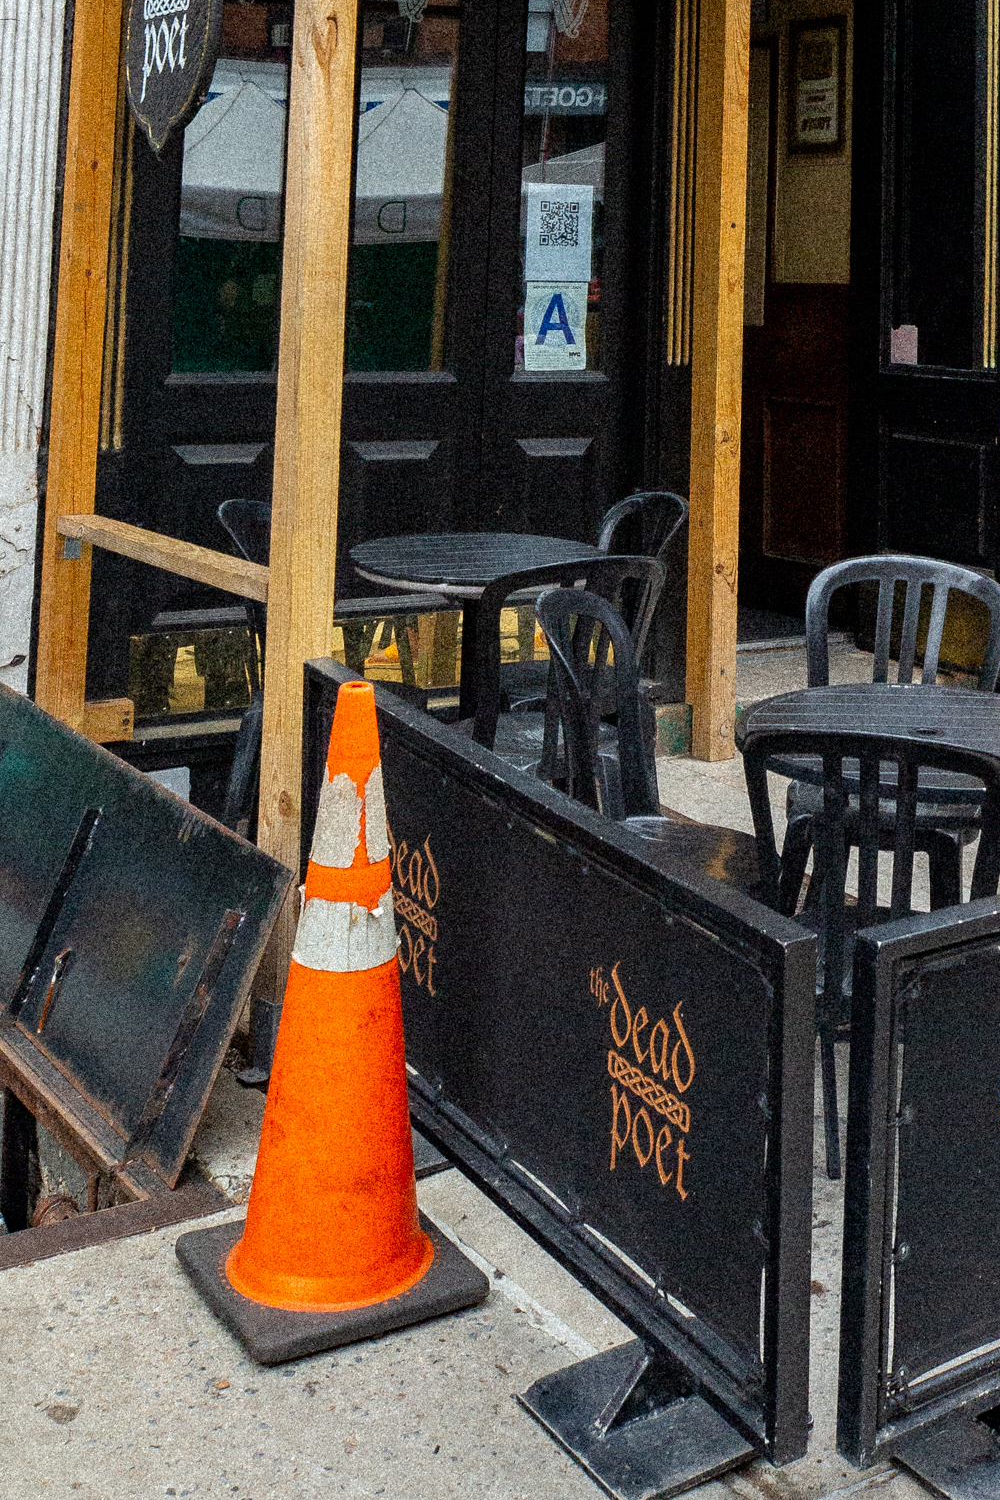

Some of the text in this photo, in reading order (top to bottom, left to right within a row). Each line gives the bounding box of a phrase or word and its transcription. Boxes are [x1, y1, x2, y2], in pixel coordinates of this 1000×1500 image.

[140, 13, 189, 103] poet
[535, 293, 576, 345] A
[397, 923, 438, 997] oet
[590, 961, 695, 1093] the dead
[610, 1083, 691, 1201] poet
